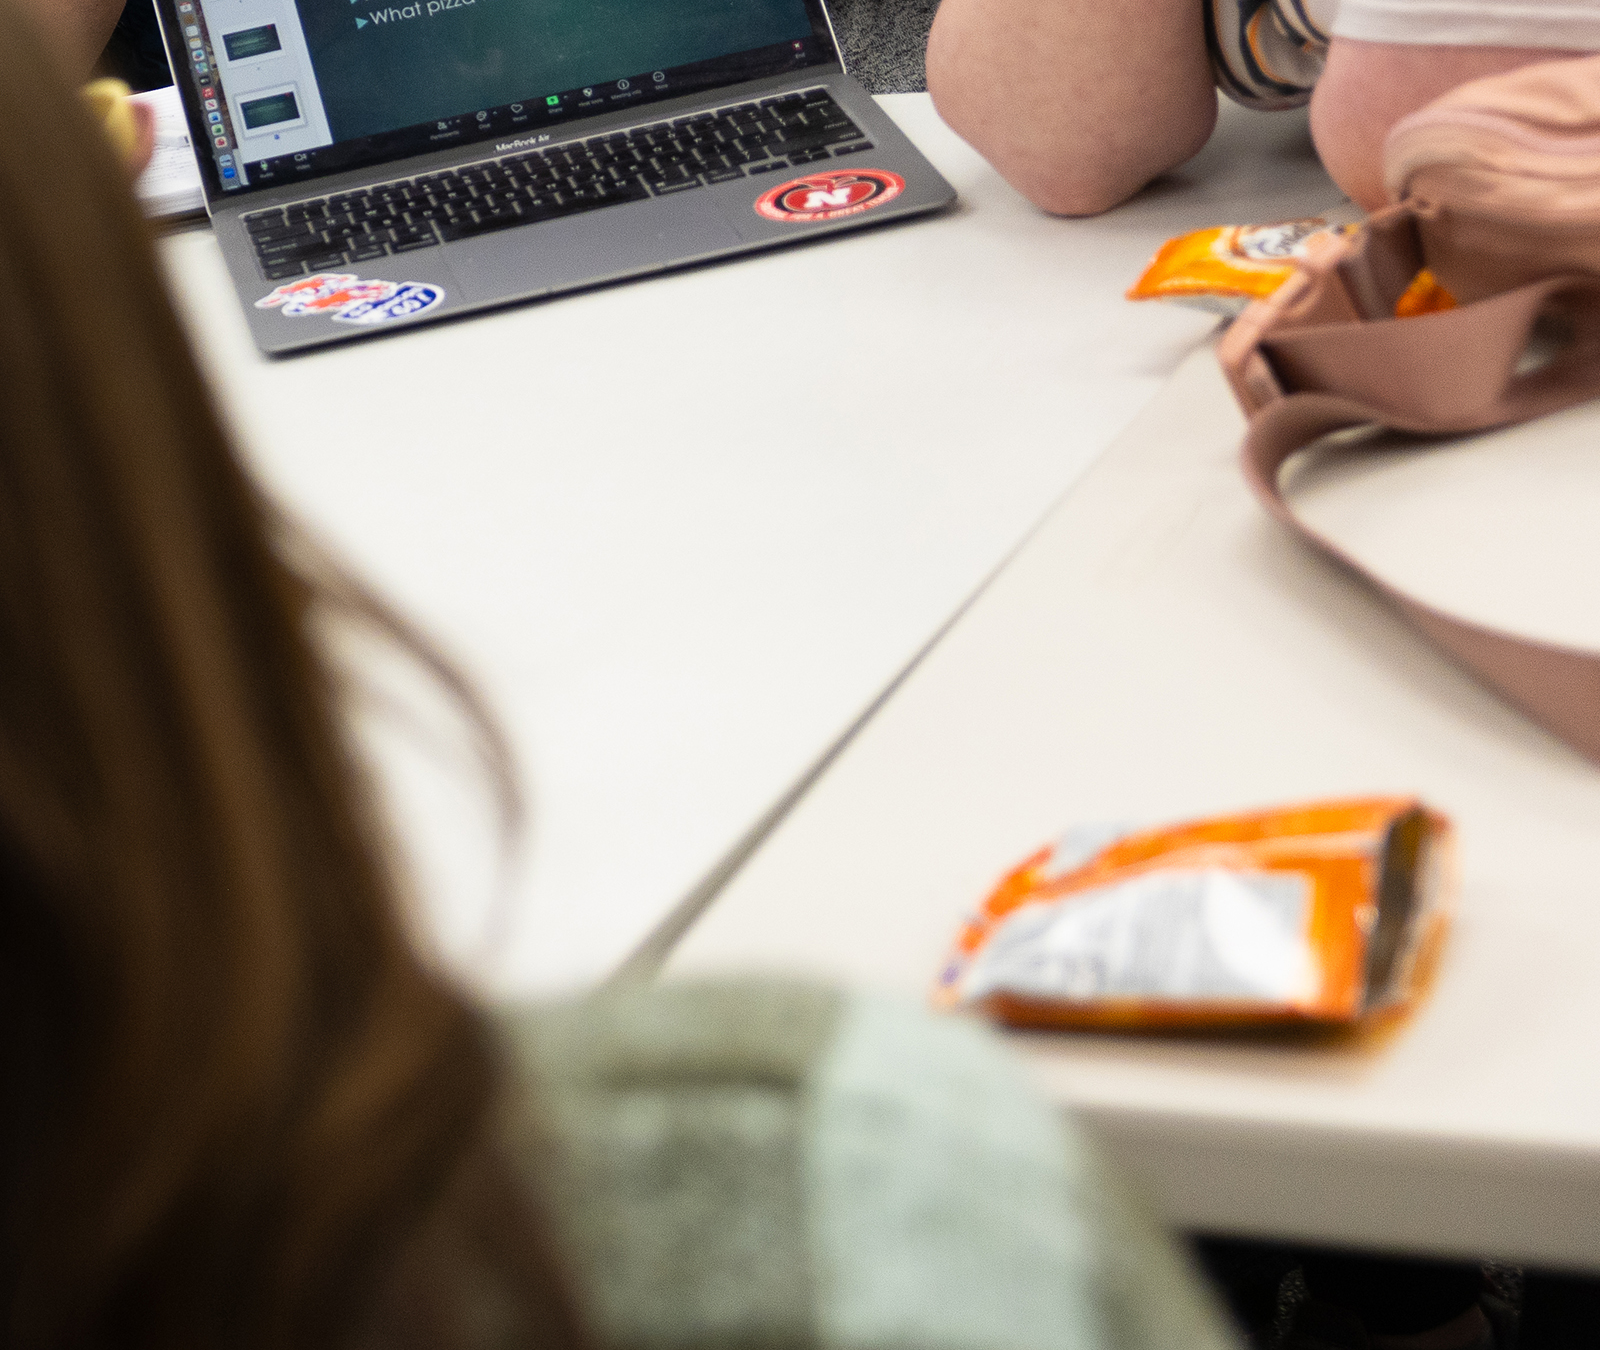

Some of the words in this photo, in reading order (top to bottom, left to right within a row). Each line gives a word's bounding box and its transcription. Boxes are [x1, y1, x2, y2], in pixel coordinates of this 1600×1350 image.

[370, 1, 422, 27] What
[496, 136, 537, 152] MacBook
[537, 133, 550, 142] Air
[803, 187, 852, 209] N
